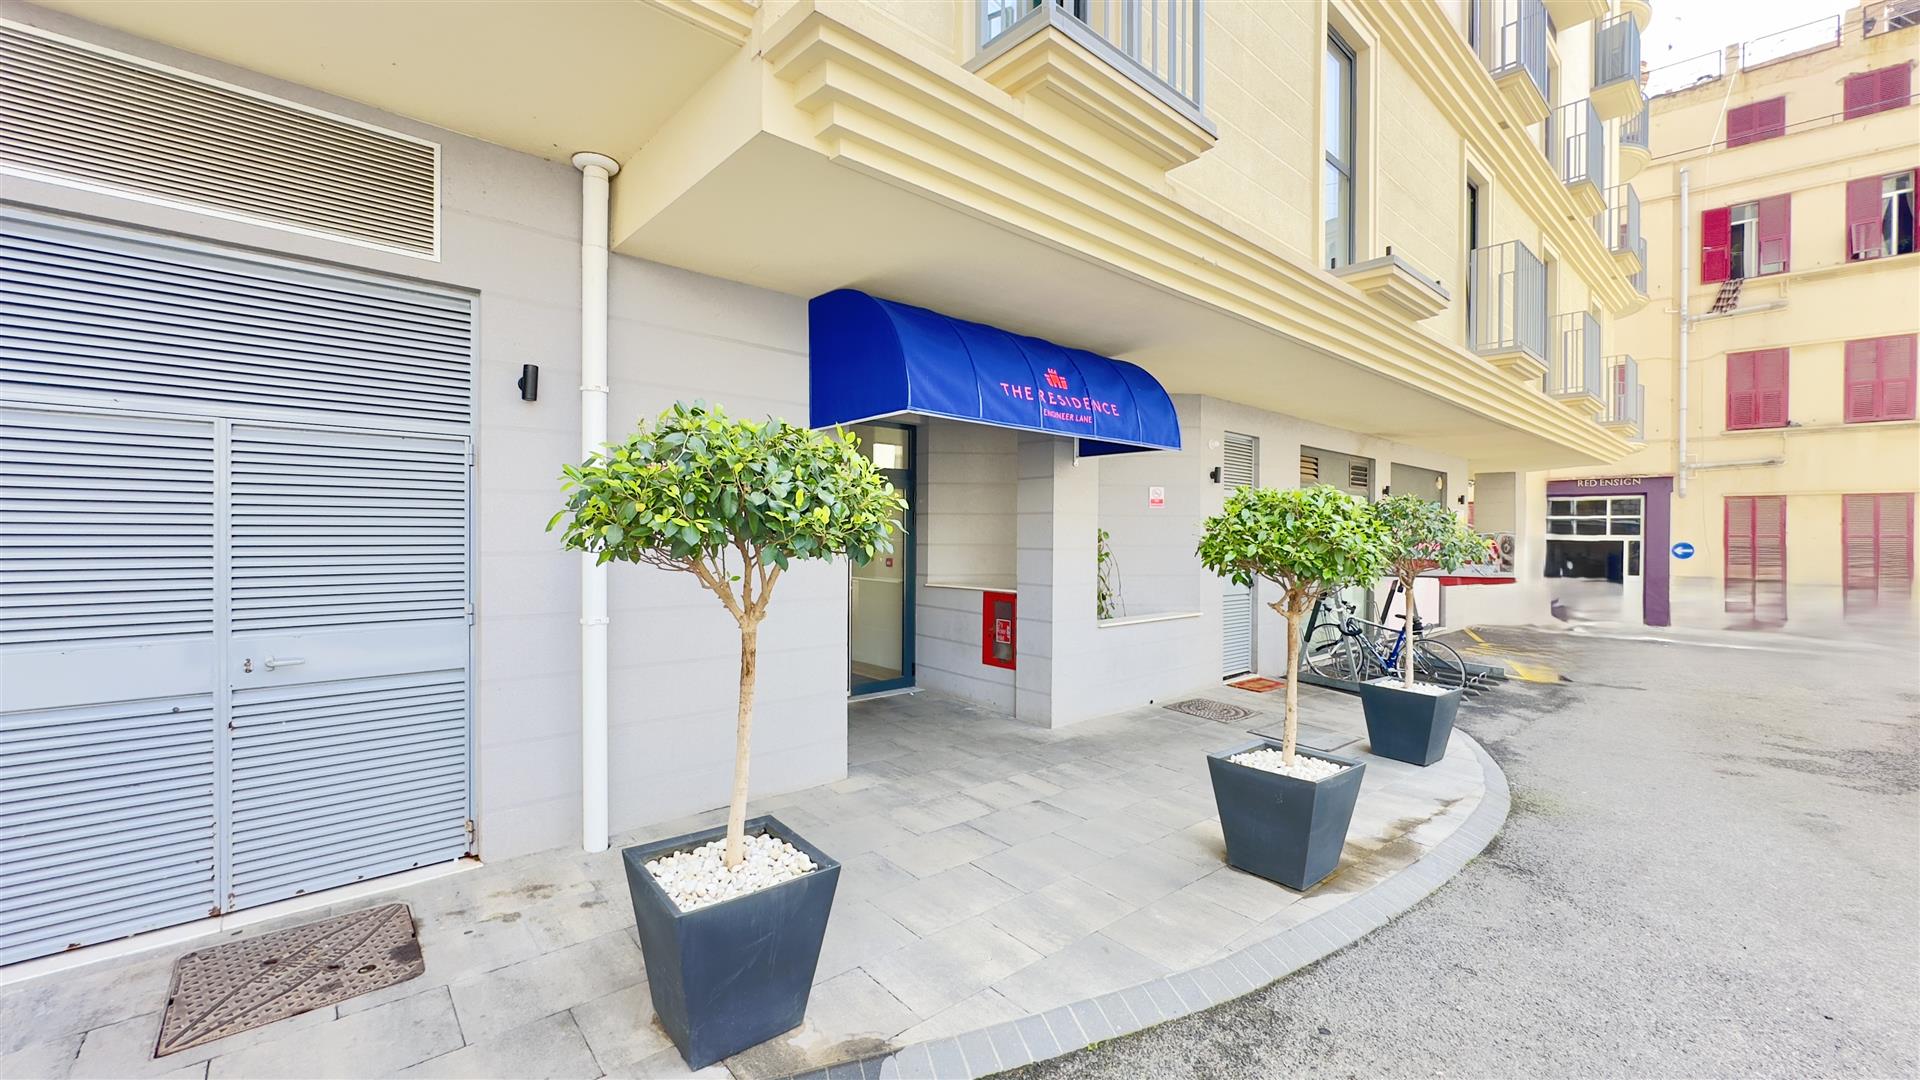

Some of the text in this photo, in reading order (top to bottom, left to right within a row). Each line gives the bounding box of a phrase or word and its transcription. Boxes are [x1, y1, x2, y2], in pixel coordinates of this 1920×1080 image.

[1000, 382, 1120, 417] THE RESIDENCE
[1043, 408, 1093, 424] ENGINEER LANE
[1577, 478, 1641, 487] RED ENSIGN
